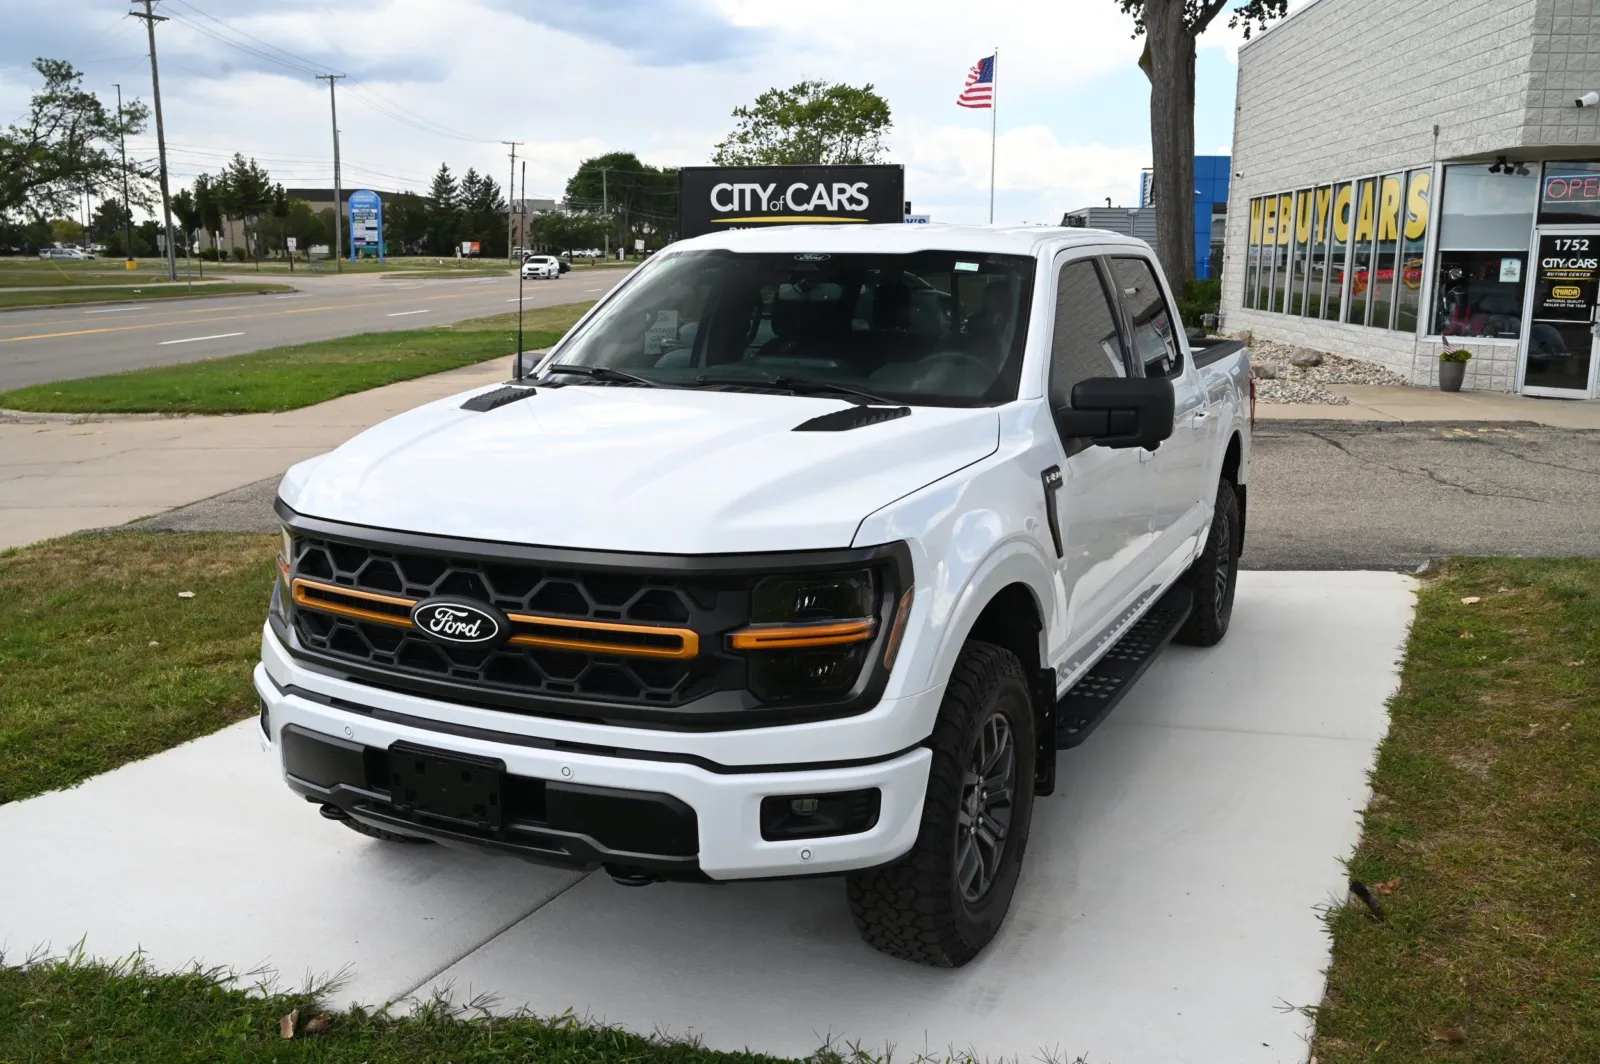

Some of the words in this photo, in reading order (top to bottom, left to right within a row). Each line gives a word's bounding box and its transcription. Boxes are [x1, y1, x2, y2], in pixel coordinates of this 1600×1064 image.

[710, 183, 777, 212] CITY
[769, 195, 786, 212] of
[785, 182, 869, 212] CARS
[1548, 179, 1600, 198] OPE
[1250, 197, 1276, 245] WE
[1277, 188, 1331, 245] BUY
[1333, 172, 1431, 242] CARS
[1554, 239, 1590, 251] 1752
[1542, 258, 1566, 268] CITY
[1568, 258, 1598, 268] CARS
[429, 607, 481, 637] Ford
